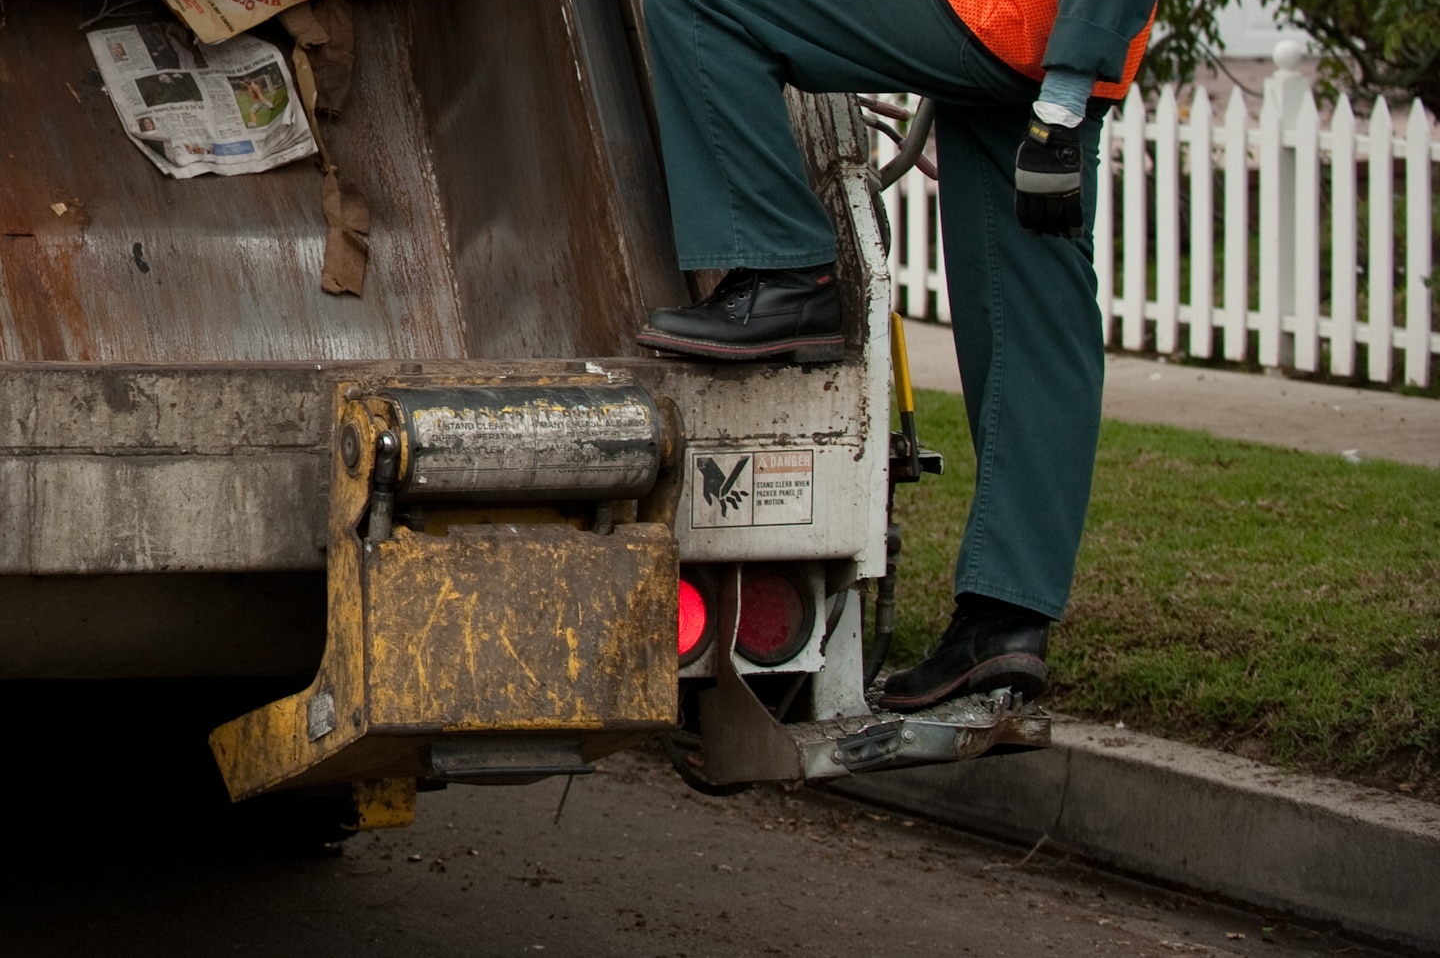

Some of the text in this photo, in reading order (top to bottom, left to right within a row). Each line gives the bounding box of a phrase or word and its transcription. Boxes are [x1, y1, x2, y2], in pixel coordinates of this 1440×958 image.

[252, 54, 275, 70] PROBLEM
[444, 421, 508, 430] STAND CLEAR
[471, 432, 522, 442] OPERATION
[770, 455, 810, 468] DANGER
[756, 488, 803, 498] PACKER PANEL IS
[756, 498, 786, 507] IN MOTION.
